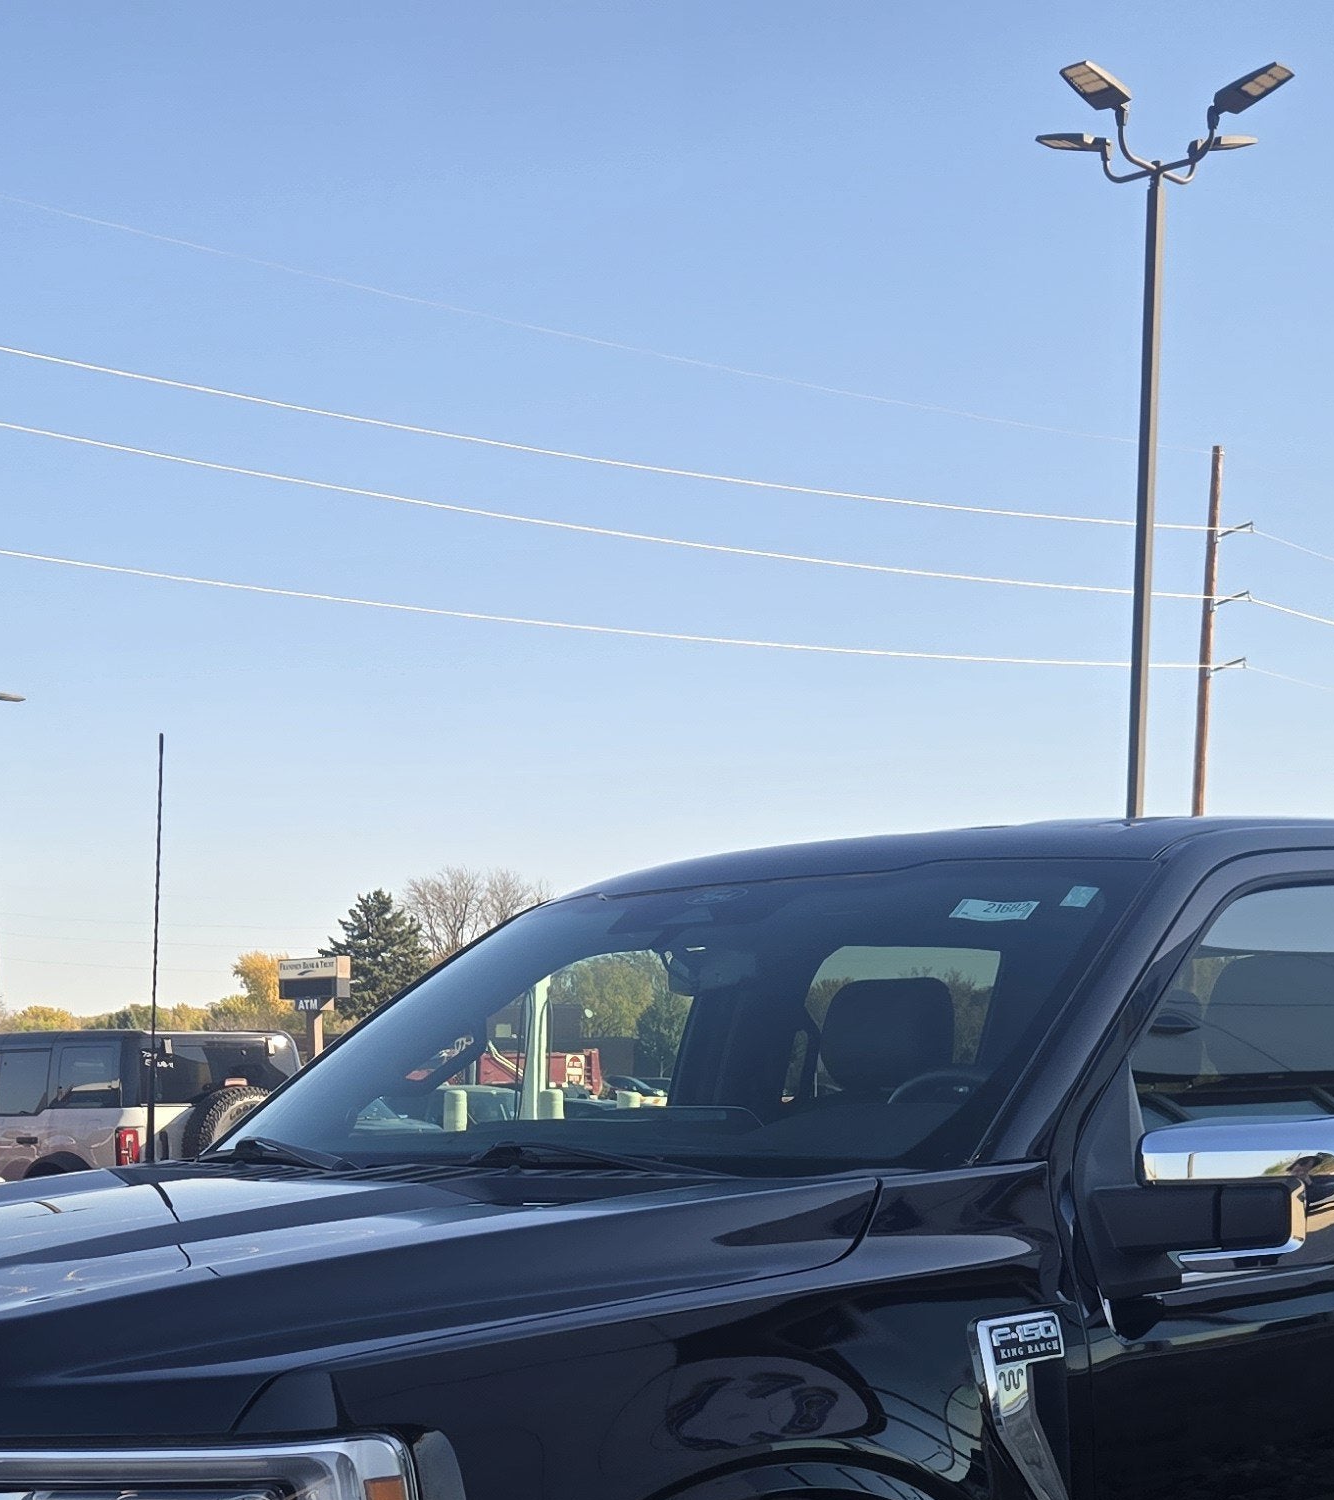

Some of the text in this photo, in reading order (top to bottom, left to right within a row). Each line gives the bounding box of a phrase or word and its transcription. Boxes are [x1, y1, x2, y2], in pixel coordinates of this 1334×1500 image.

[298, 999, 318, 1010] ATM
[992, 1320, 1058, 1346] F-150
[1000, 1340, 1059, 1359] KING RANCH
